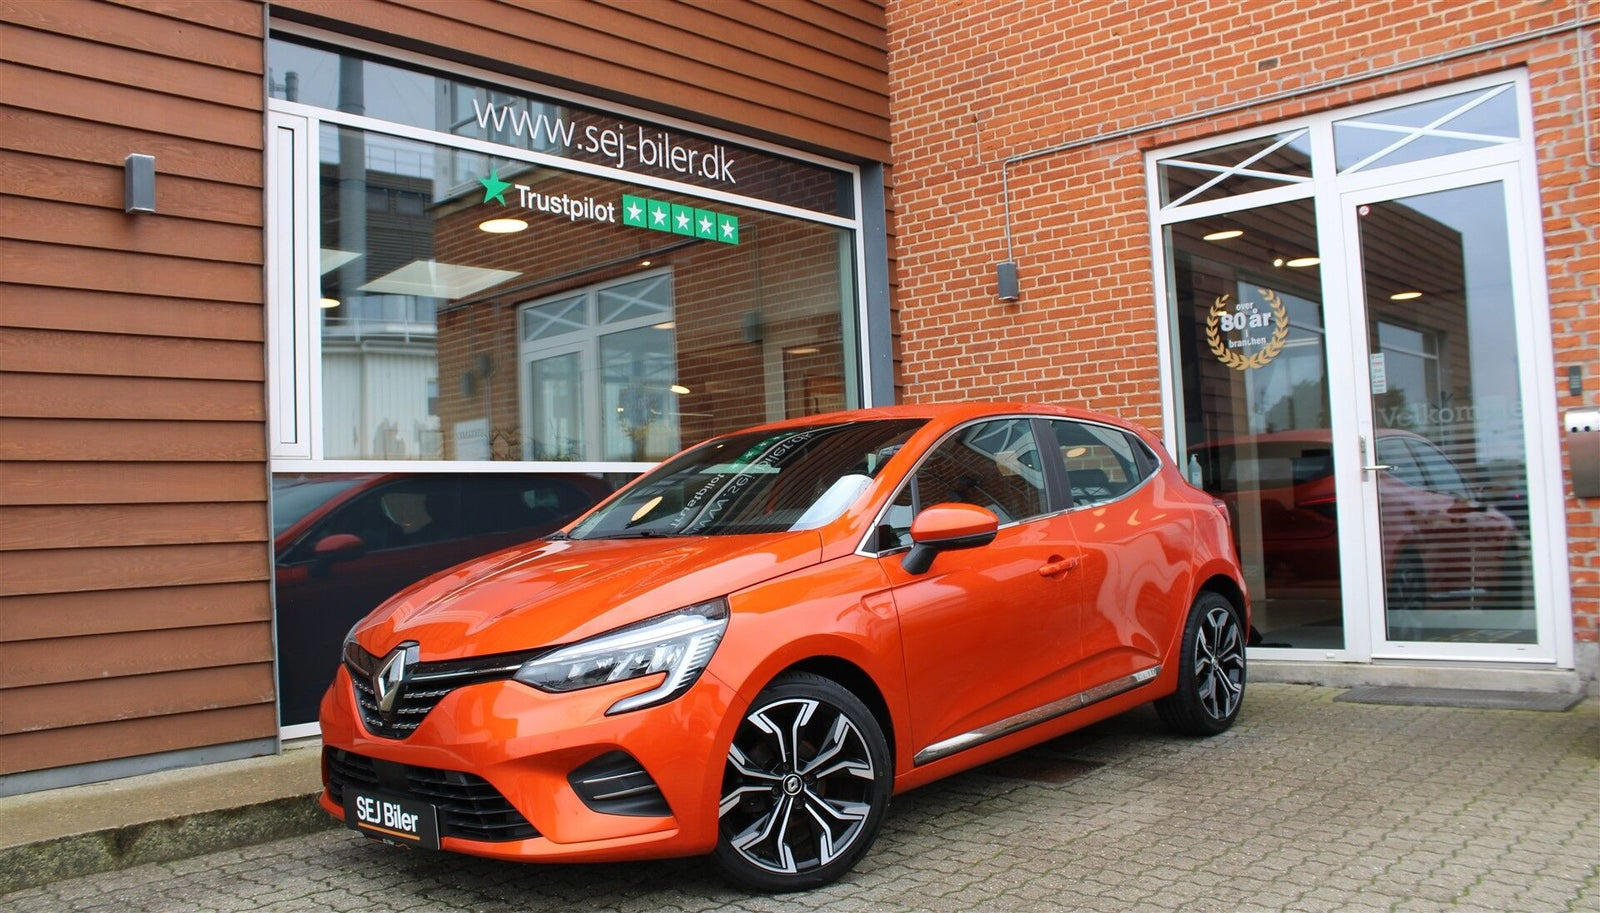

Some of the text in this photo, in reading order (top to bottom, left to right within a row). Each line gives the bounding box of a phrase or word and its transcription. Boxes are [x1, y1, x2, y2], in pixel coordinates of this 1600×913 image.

[472, 98, 736, 184] www.sej-biler.dk
[514, 183, 616, 223] Trustpilot
[1220, 308, 1272, 332] 80 år
[1235, 302, 1254, 311] over
[356, 795, 418, 832] SEJ Biler
